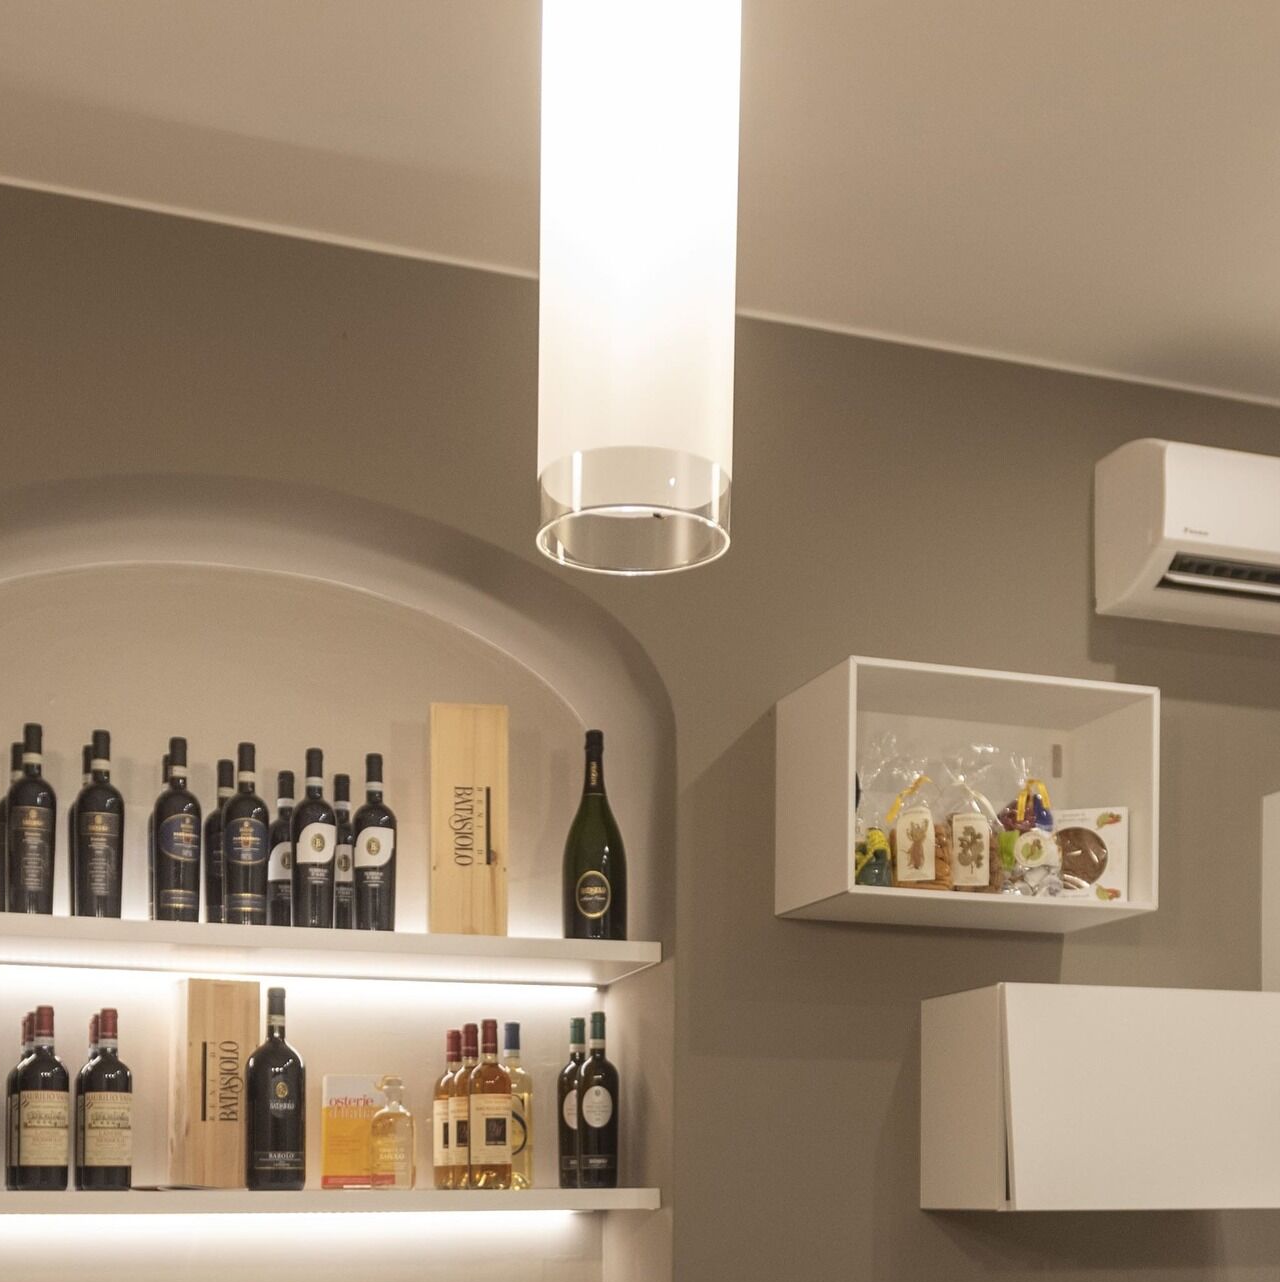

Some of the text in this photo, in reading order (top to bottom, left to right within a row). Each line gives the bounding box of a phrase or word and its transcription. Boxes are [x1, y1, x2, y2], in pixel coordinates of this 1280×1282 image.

[448, 786, 475, 867] BATASIOLO
[219, 1040, 244, 1121] BATASIOLO
[329, 1094, 375, 1107] osterie
